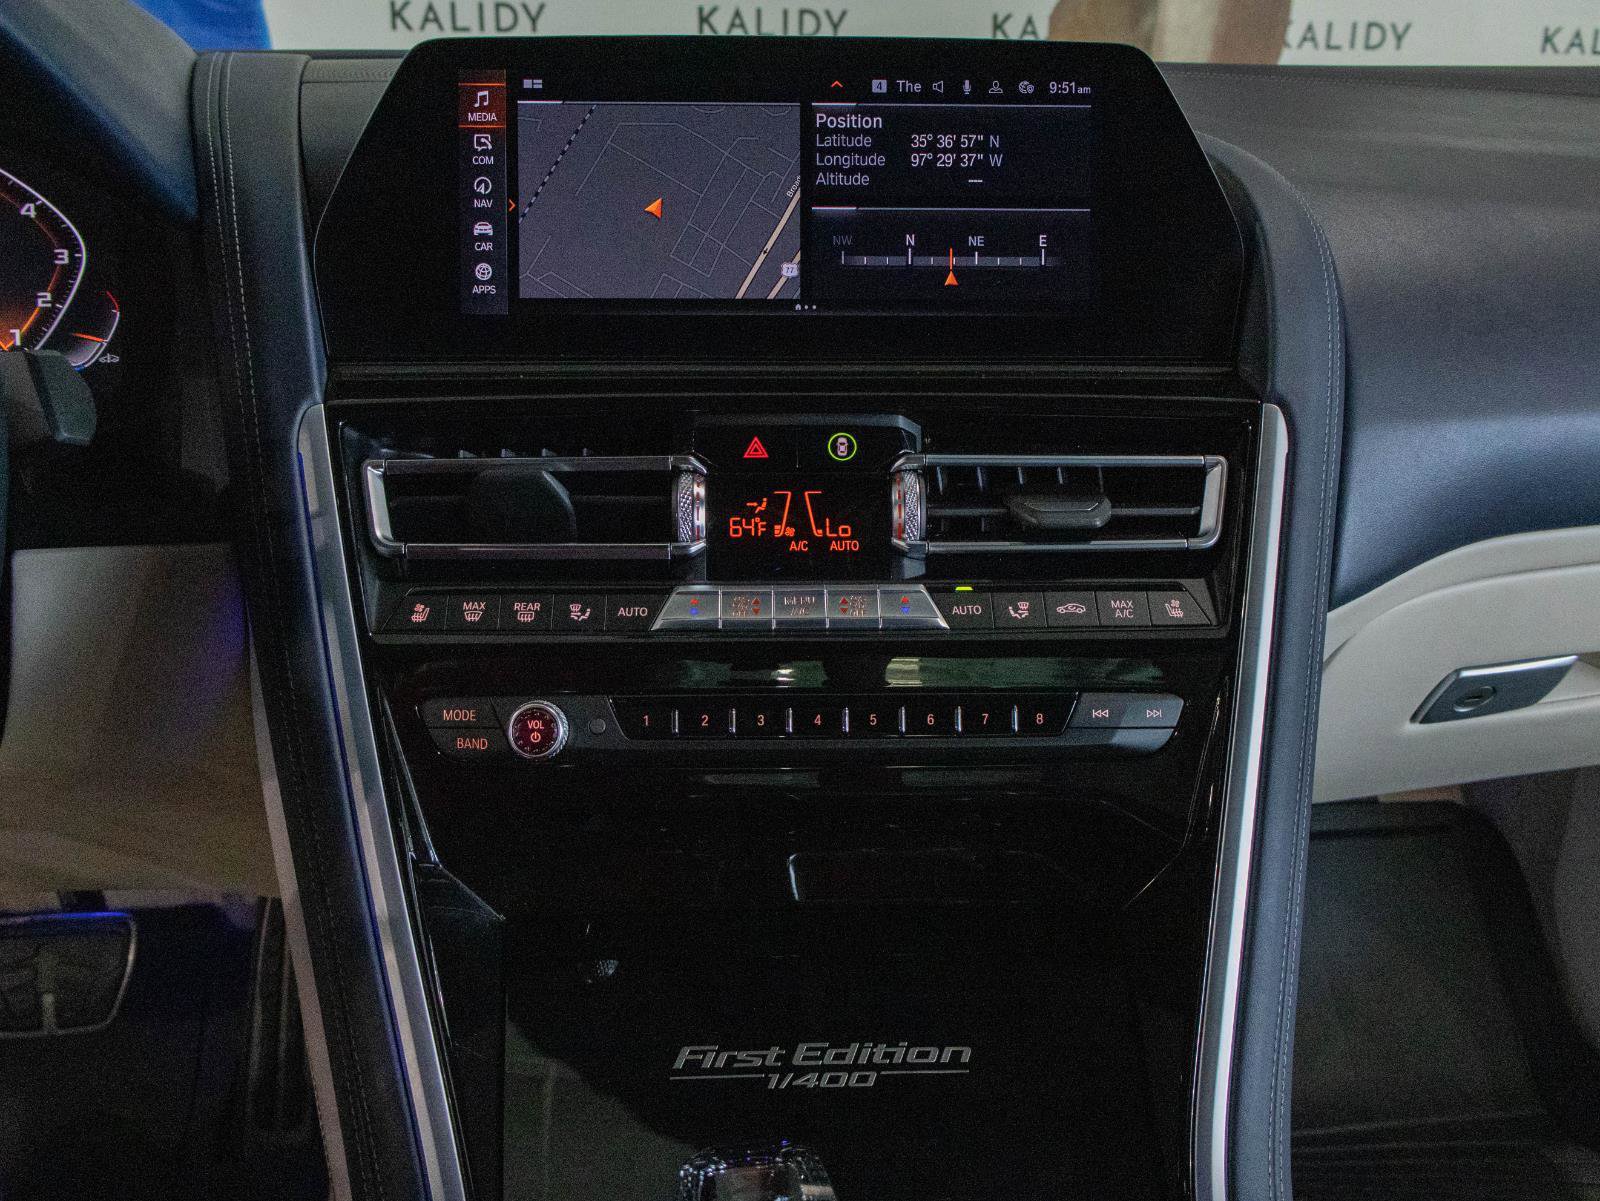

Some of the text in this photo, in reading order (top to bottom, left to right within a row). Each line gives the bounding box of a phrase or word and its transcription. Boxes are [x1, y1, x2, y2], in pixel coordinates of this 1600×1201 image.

[390, 1, 546, 32] KALIDY
[697, 5, 848, 35] KALIDY
[1284, 21, 1412, 50] ALIDY
[896, 80, 922, 93] The
[467, 112, 497, 122] MEDIA
[815, 113, 883, 129] Position
[815, 134, 872, 147] Latitude
[910, 134, 934, 148] 35°
[989, 135, 1000, 148] N
[472, 156, 494, 165] COM
[815, 153, 886, 168] Longitude
[910, 153, 934, 167] 97°
[989, 154, 1003, 167] W
[815, 173, 870, 186] Altitude
[474, 199, 493, 208] NAV
[20, 203, 37, 218] 4
[833, 236, 852, 247] NW
[905, 235, 915, 246] N
[968, 236, 985, 247] NE
[1039, 235, 1047, 247] E
[474, 242, 493, 251] CAR
[54, 249, 69, 264] 3
[785, 266, 795, 275] 77
[472, 285, 496, 294] APPS
[37, 292, 52, 307] 2
[9, 329, 21, 346] 1
[826, 518, 851, 537] Lo
[789, 541, 809, 551] A/C
[830, 541, 860, 551] AUTO
[463, 602, 486, 610] MAX
[514, 602, 540, 611] REAR
[952, 605, 982, 615] AUTO
[1111, 600, 1134, 609] MAX
[618, 606, 648, 617] AUTO
[1115, 609, 1134, 618] A/C
[443, 709, 477, 721] MODE
[643, 715, 650, 726] 1
[701, 715, 709, 726] 2
[757, 715, 765, 726] 3
[814, 714, 822, 726] 4
[869, 714, 877, 725] 5
[926, 714, 935, 725] 6
[981, 714, 989, 725] 7
[1036, 713, 1044, 725] 8
[527, 719, 545, 730] VOL
[456, 737, 488, 750] BAND
[672, 1041, 972, 1069] First Edition
[767, 1071, 877, 1089] 1/400
